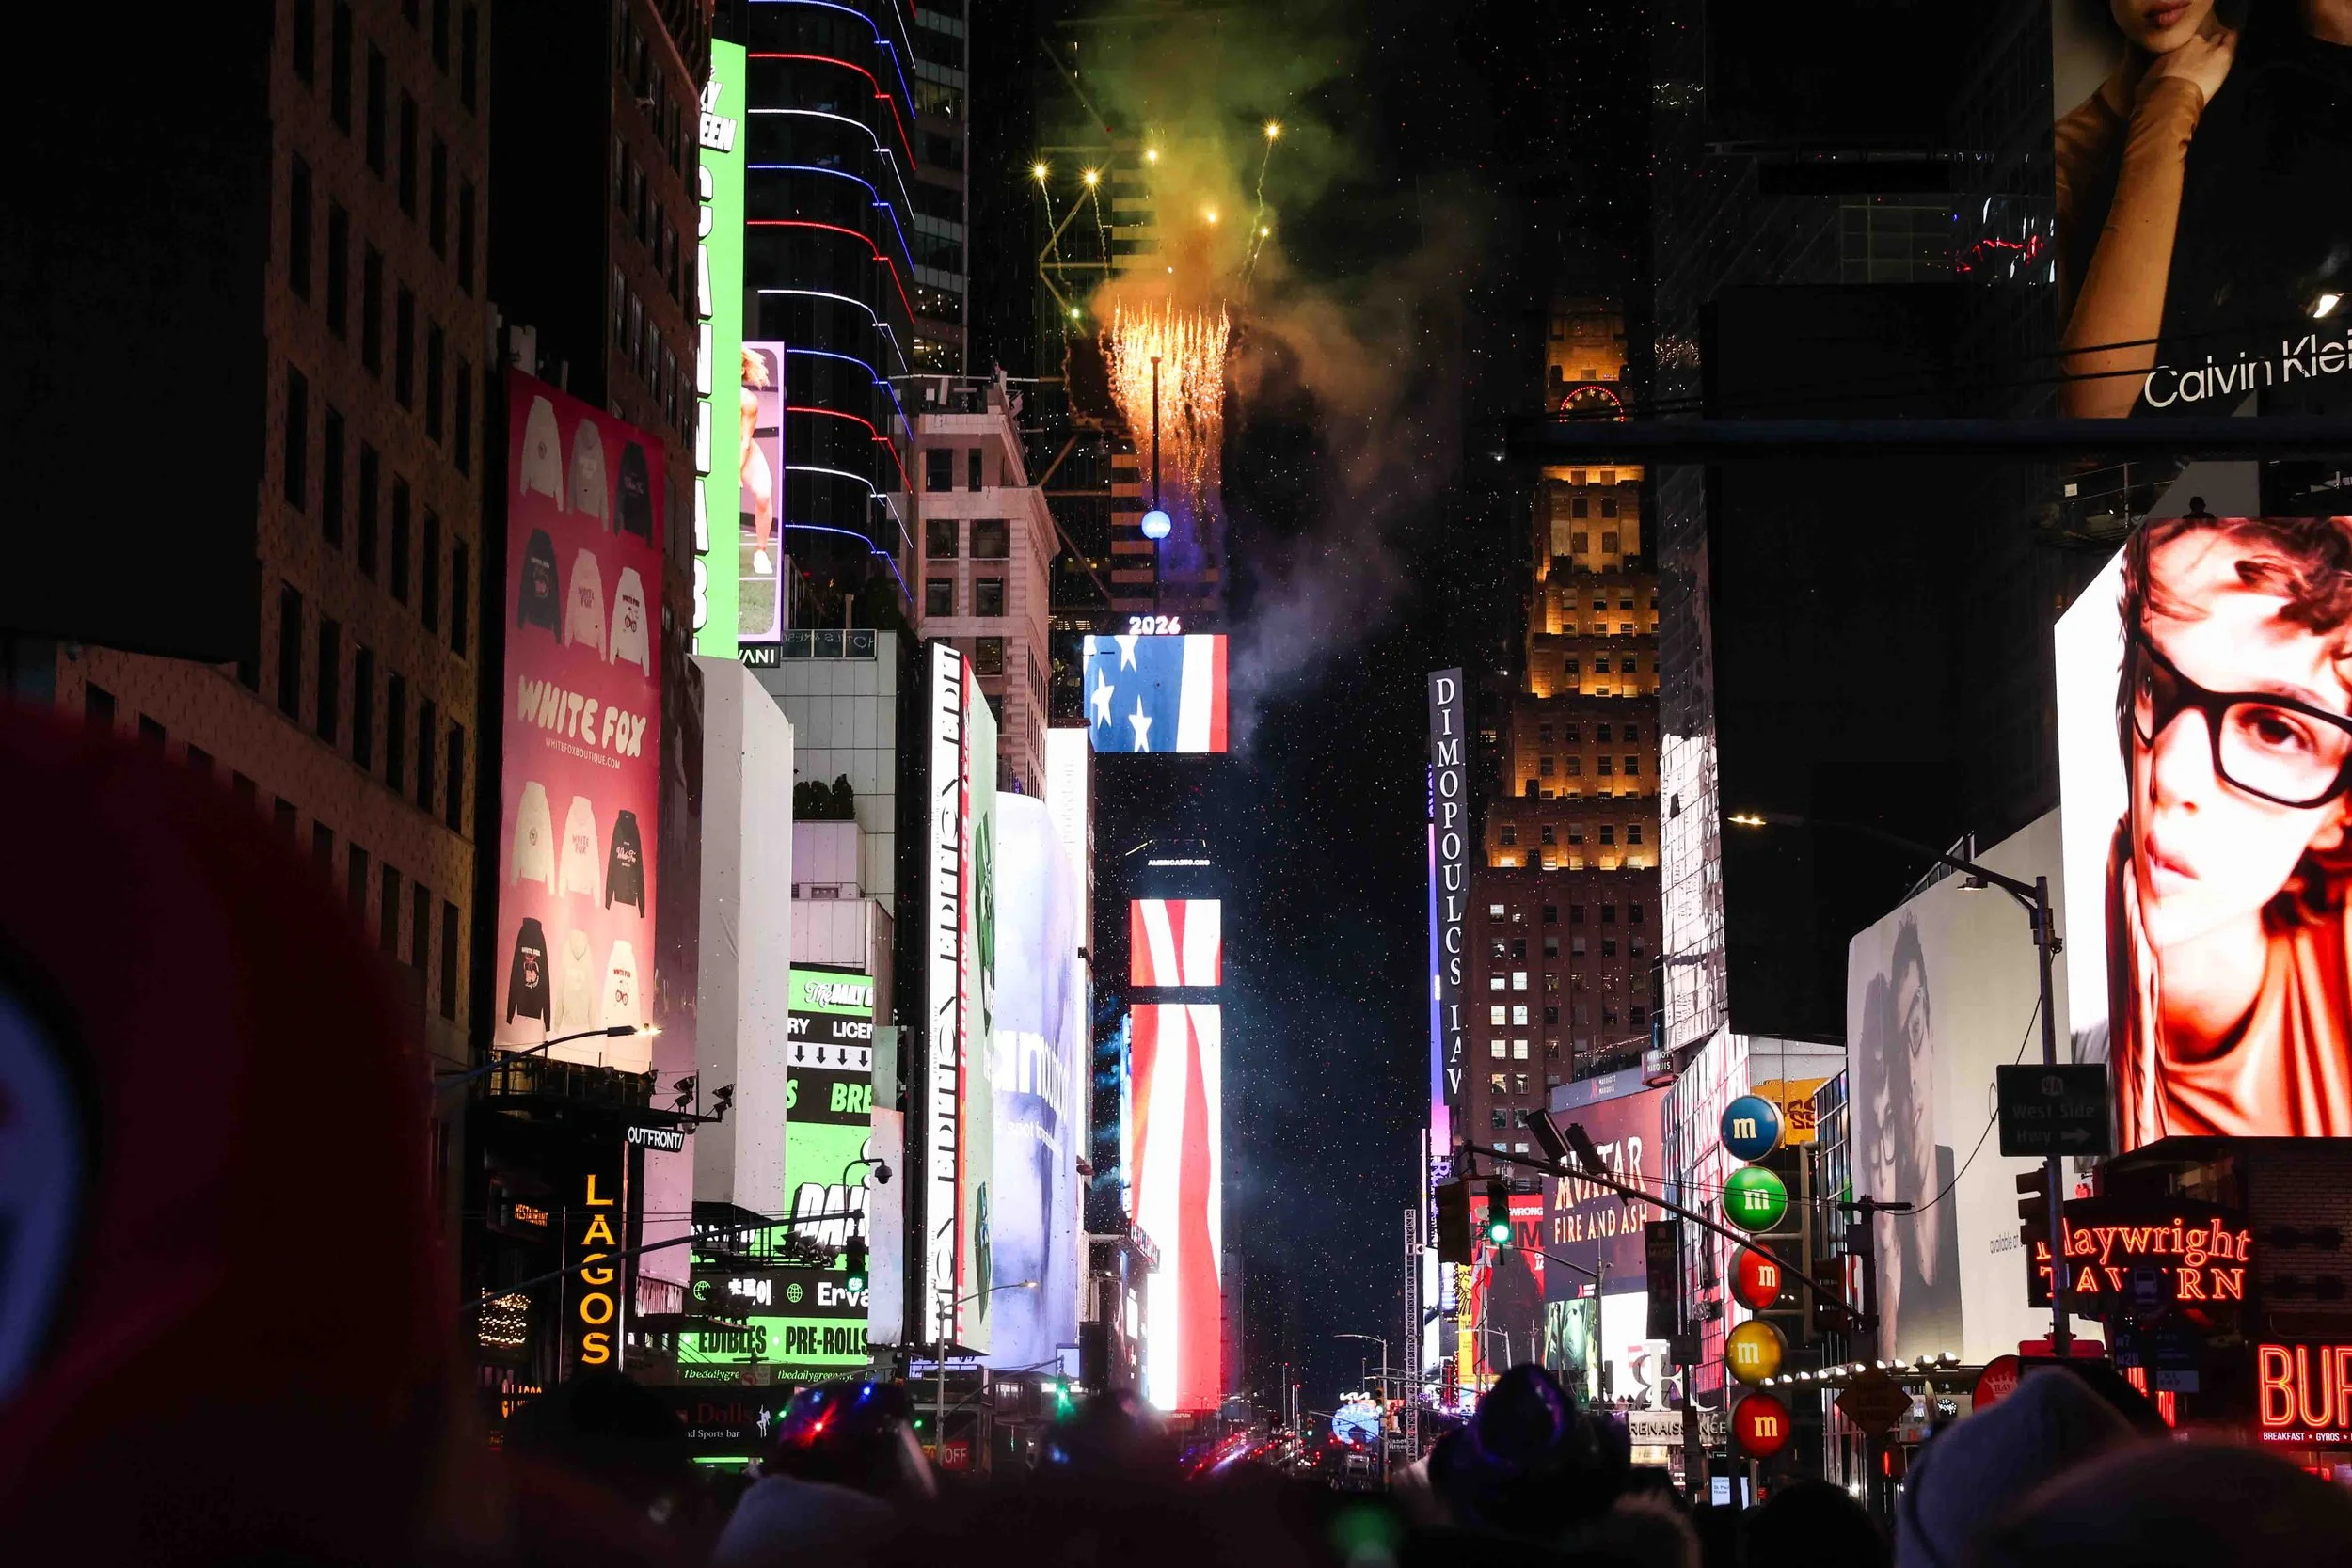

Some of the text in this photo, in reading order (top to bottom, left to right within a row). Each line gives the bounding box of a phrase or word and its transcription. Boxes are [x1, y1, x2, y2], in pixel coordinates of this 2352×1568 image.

[2144, 351, 2272, 408] Calvin
[1129, 615, 1182, 636] 2026
[518, 674, 647, 758] WHITE FOX
[545, 736, 621, 770] WHITEFOXBOUTIQUE.COM
[2011, 1103, 2096, 1119] West Side
[1732, 1117, 1757, 1139] m
[2016, 1129, 2052, 1147] Hwy
[1742, 1188, 1771, 1211] m
[1509, 1206, 1544, 1216] WRONG
[1554, 1203, 1647, 1244] FIRE AND ASH
[580, 1174, 616, 1365] LAGOS
[1758, 1264, 1776, 1288] m
[698, 1324, 768, 1354] EDIBLES
[697, 1429, 724, 1440] Sports
[726, 1429, 740, 1438] bar
[1629, 1421, 1727, 1437] RENAISNCE
[1754, 1415, 1778, 1438] m
[2263, 1431, 2340, 1442] BREAKFAST GYROS
[945, 1447, 968, 1465] OFF
